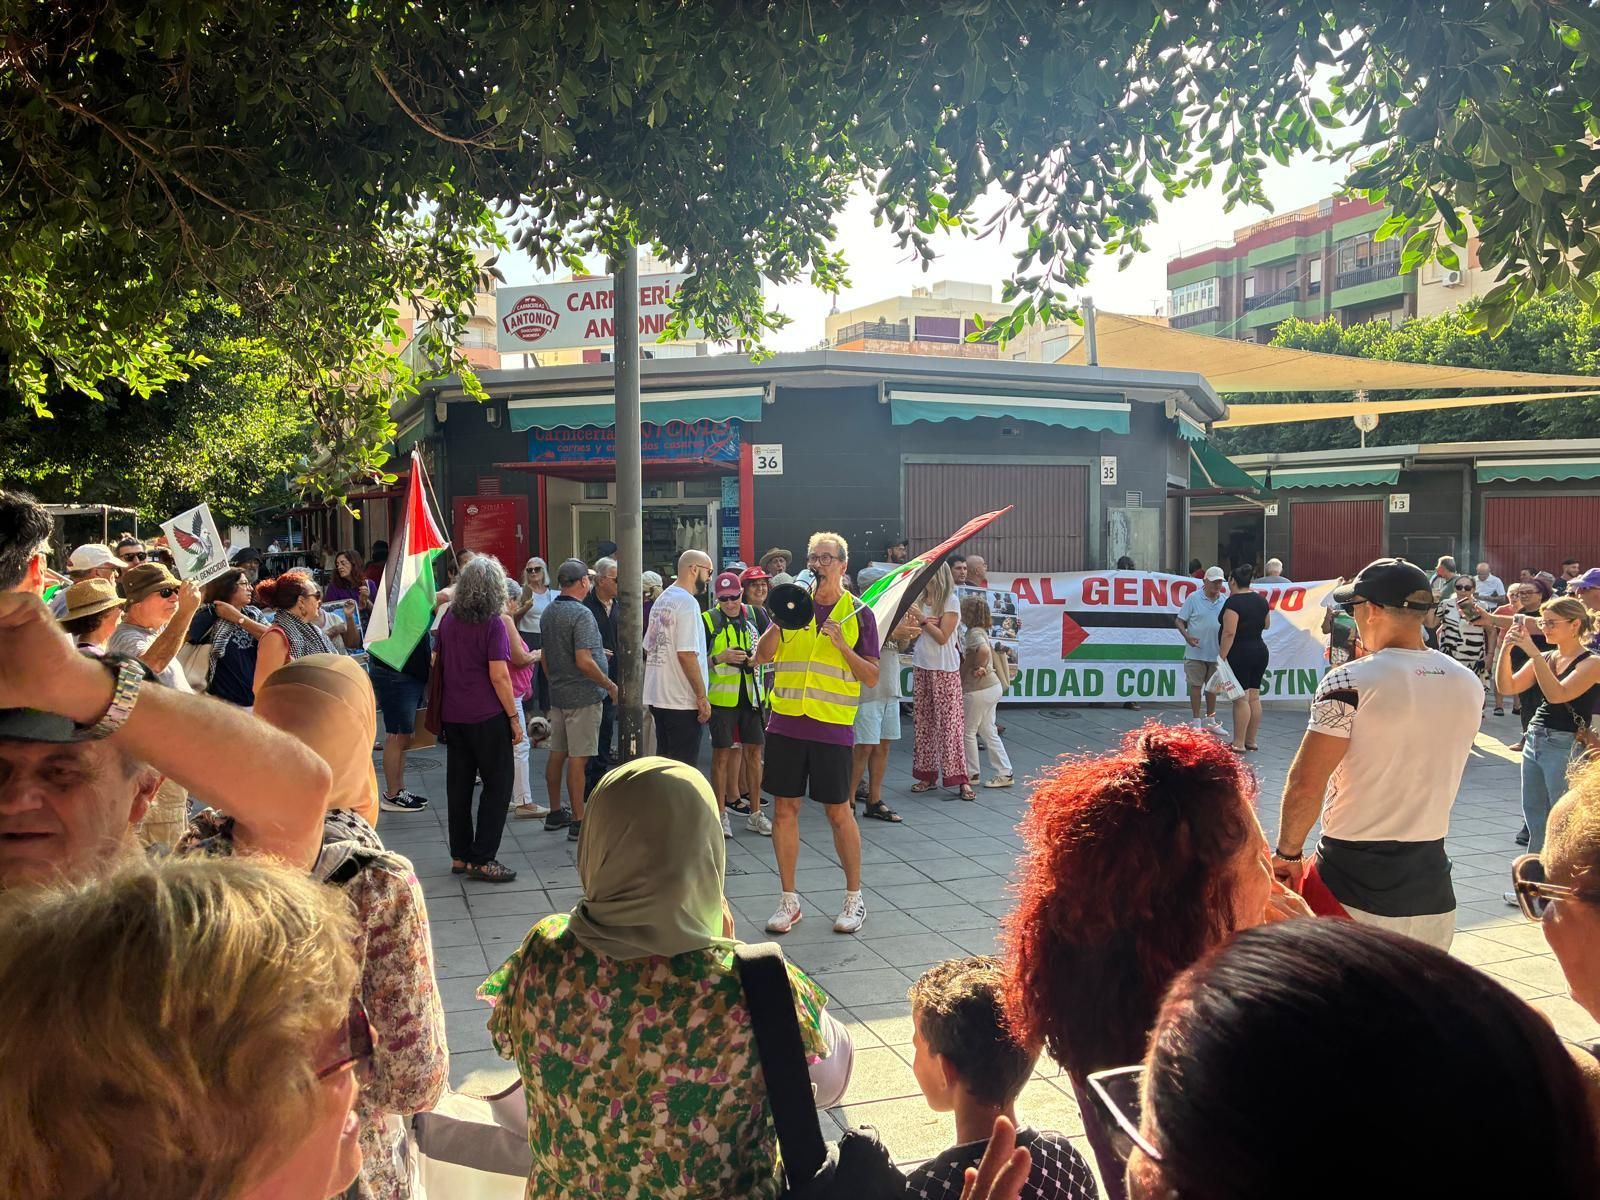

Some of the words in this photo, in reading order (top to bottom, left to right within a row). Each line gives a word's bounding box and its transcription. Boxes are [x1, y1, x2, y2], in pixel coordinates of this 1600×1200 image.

[511, 312, 553, 329] ANTONIO
[757, 456, 778, 469] 36
[1103, 467, 1114, 479] 35
[1394, 500, 1405, 510] 13
[1011, 577, 1066, 605] AL
[1116, 668, 1177, 697] CON
